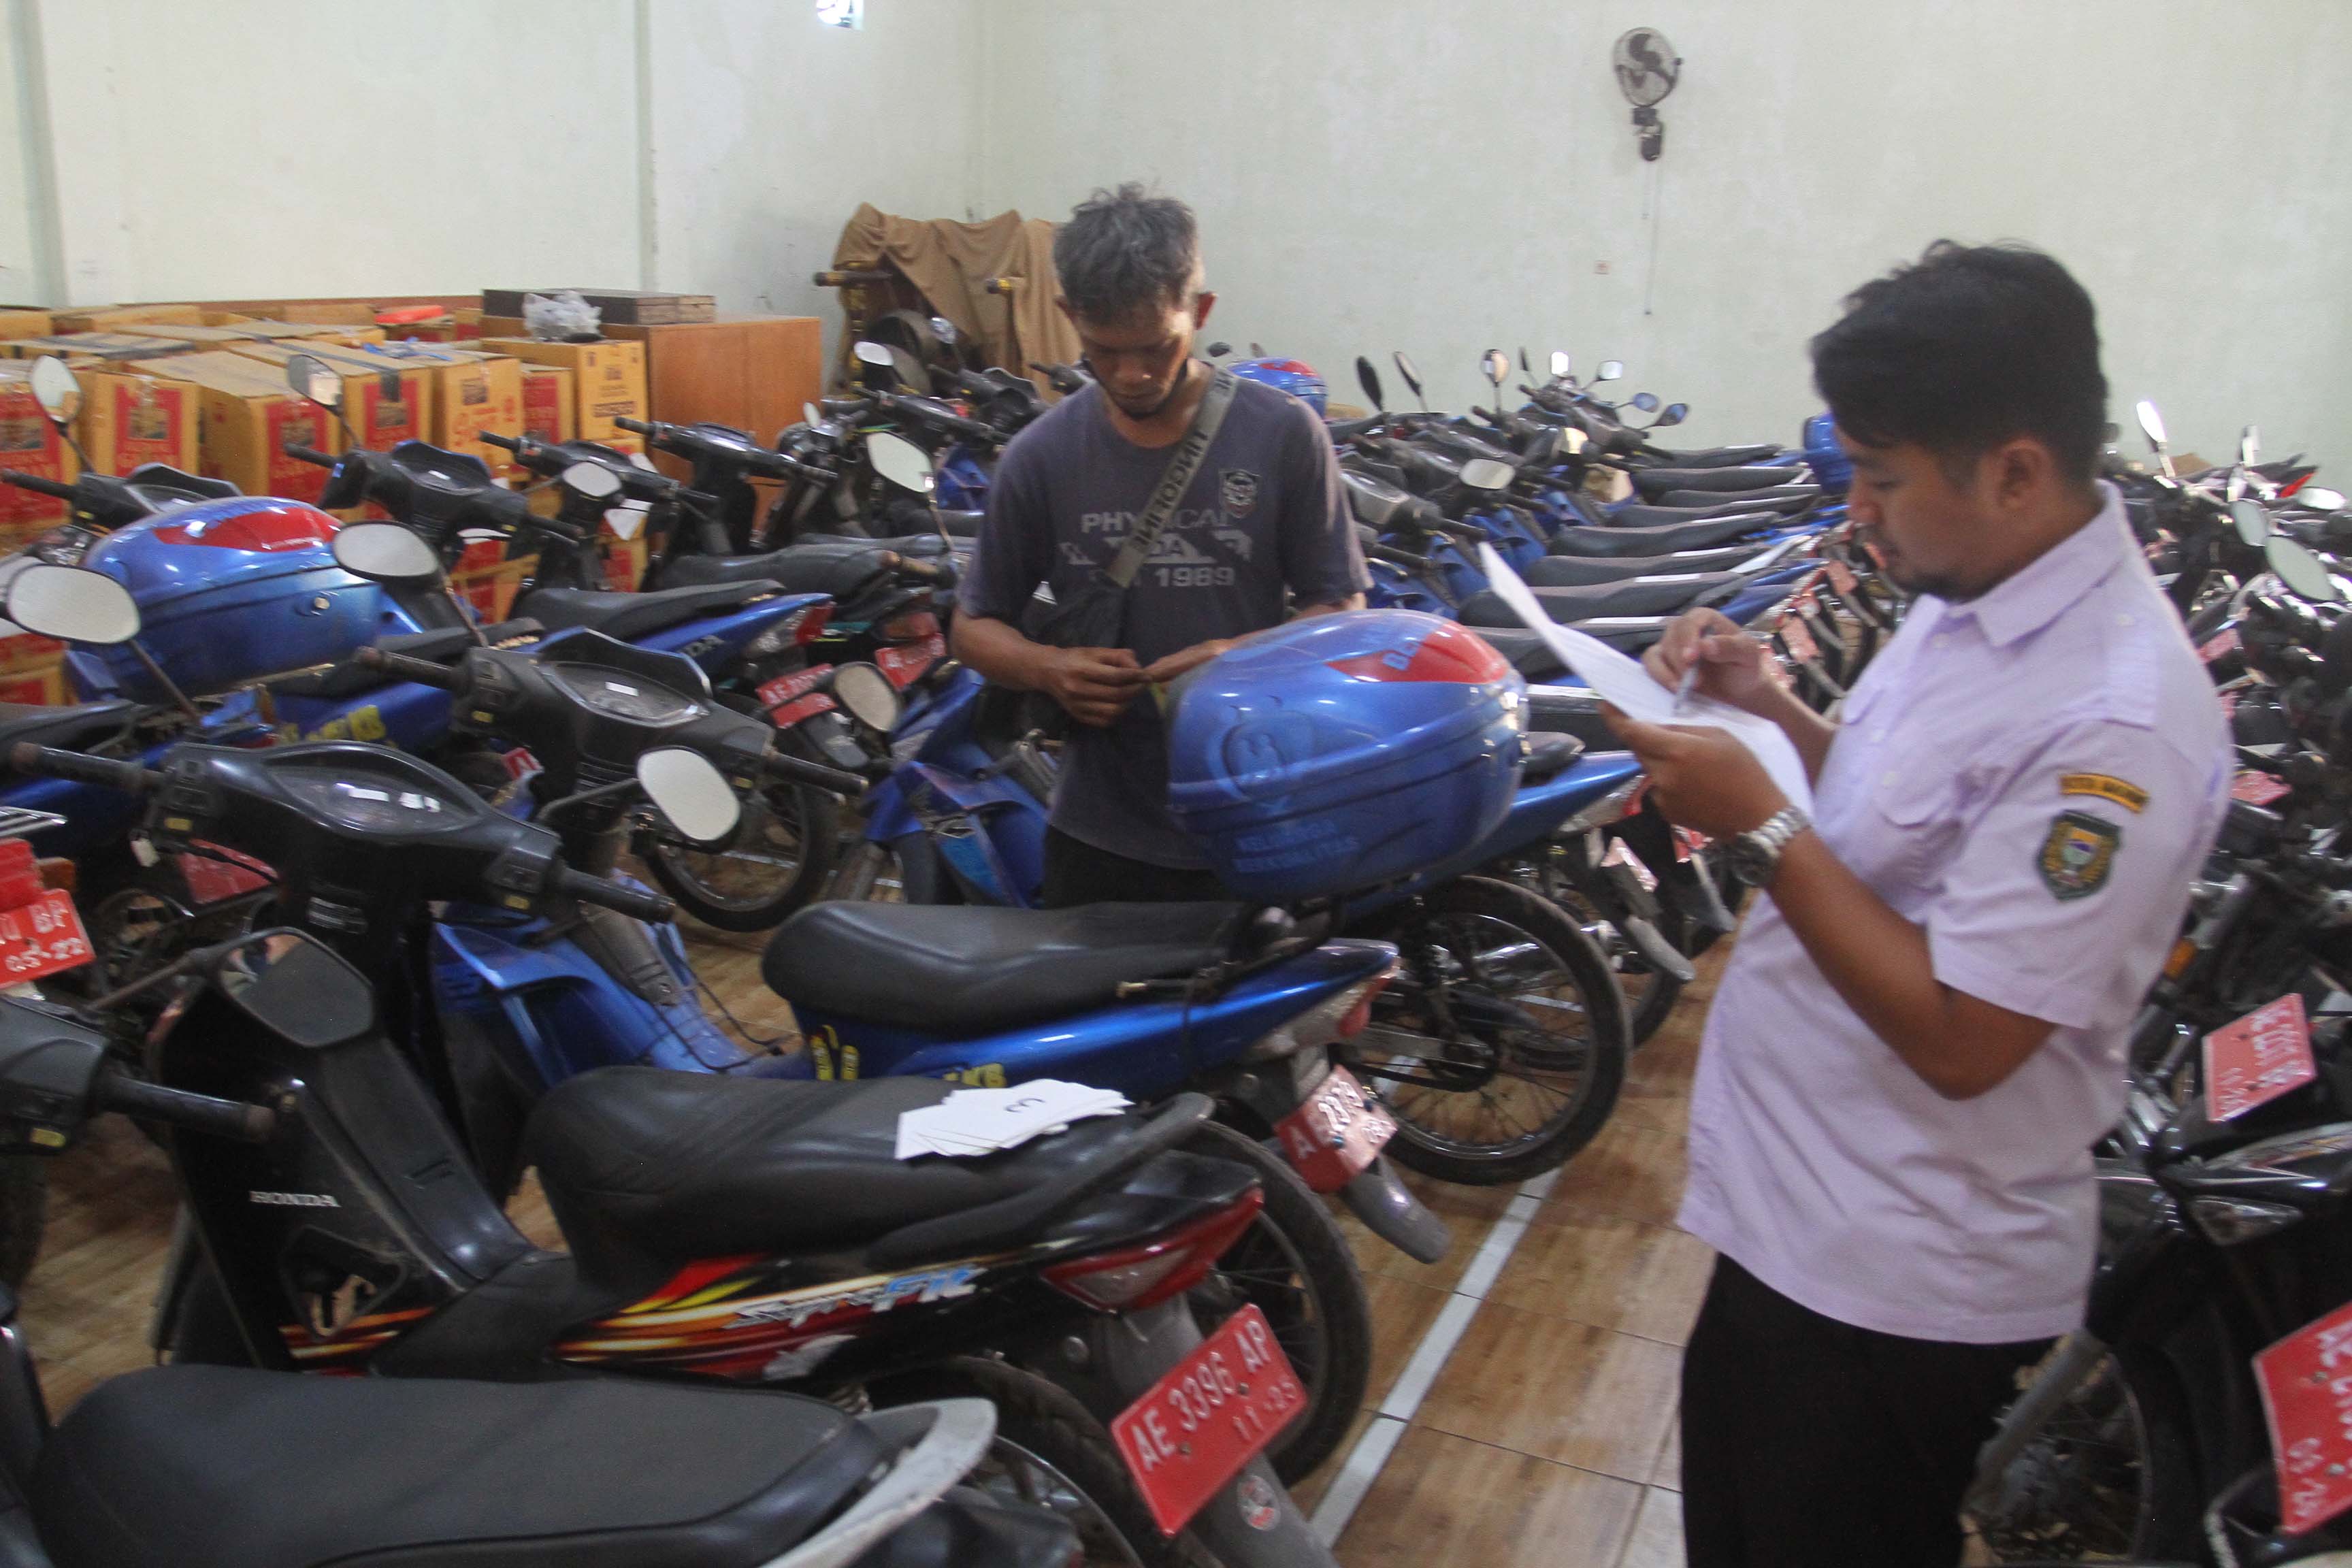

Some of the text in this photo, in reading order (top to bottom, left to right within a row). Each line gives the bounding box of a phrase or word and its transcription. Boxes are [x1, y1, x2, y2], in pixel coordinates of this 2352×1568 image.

[1156, 567, 1235, 587] 1989
[249, 1190, 342, 1207] HONDA
[1130, 1320, 1273, 1473] AE 3396 AP
